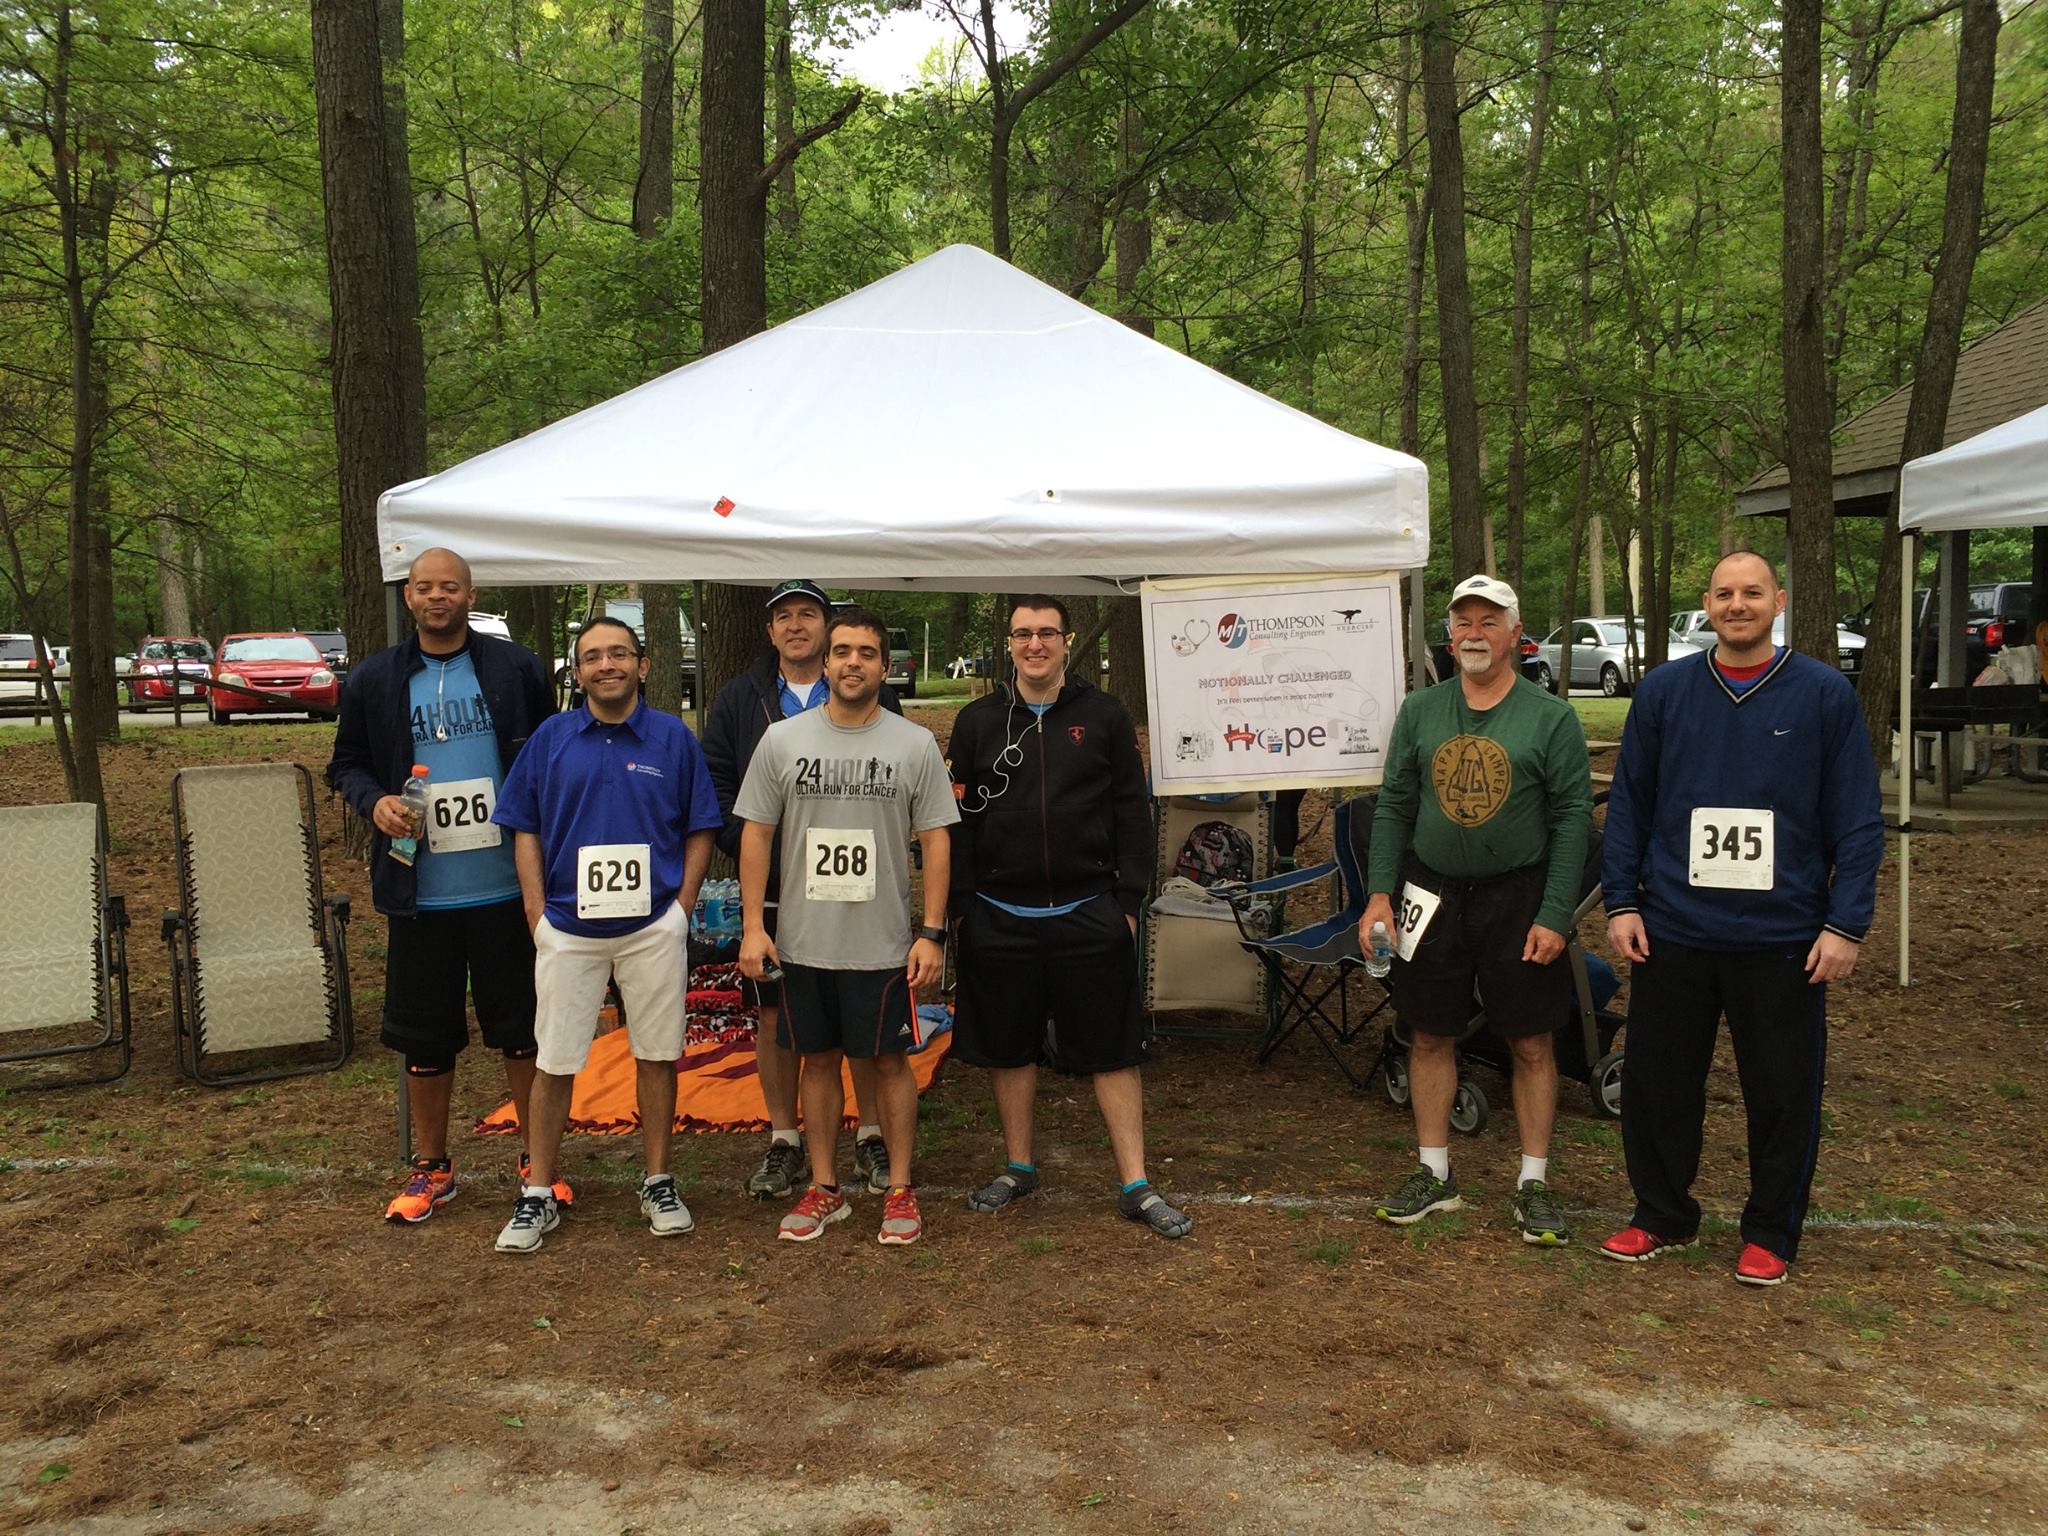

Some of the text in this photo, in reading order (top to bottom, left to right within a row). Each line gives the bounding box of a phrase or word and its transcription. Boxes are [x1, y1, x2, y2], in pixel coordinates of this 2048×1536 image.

[1247, 615, 1325, 631] THOMPSON
[1249, 628, 1326, 641] Consulting Engineers
[1198, 670, 1352, 689] MOTIONALLY CHALLENGED
[410, 696, 485, 731] 4 HOU
[410, 730, 429, 743] TRA
[431, 723, 451, 740] RN
[453, 720, 475, 736] FOR
[476, 717, 494, 732] CAN
[796, 758, 822, 785] 24
[1436, 743, 1505, 796] HAPPY CAMPER
[796, 783, 897, 799] ULTRA RUN FOR CANCER
[434, 793, 488, 828] 626
[1702, 824, 1762, 861] 345
[588, 859, 641, 892] 629
[816, 844, 867, 876] 268
[1400, 896, 1424, 933] 59
